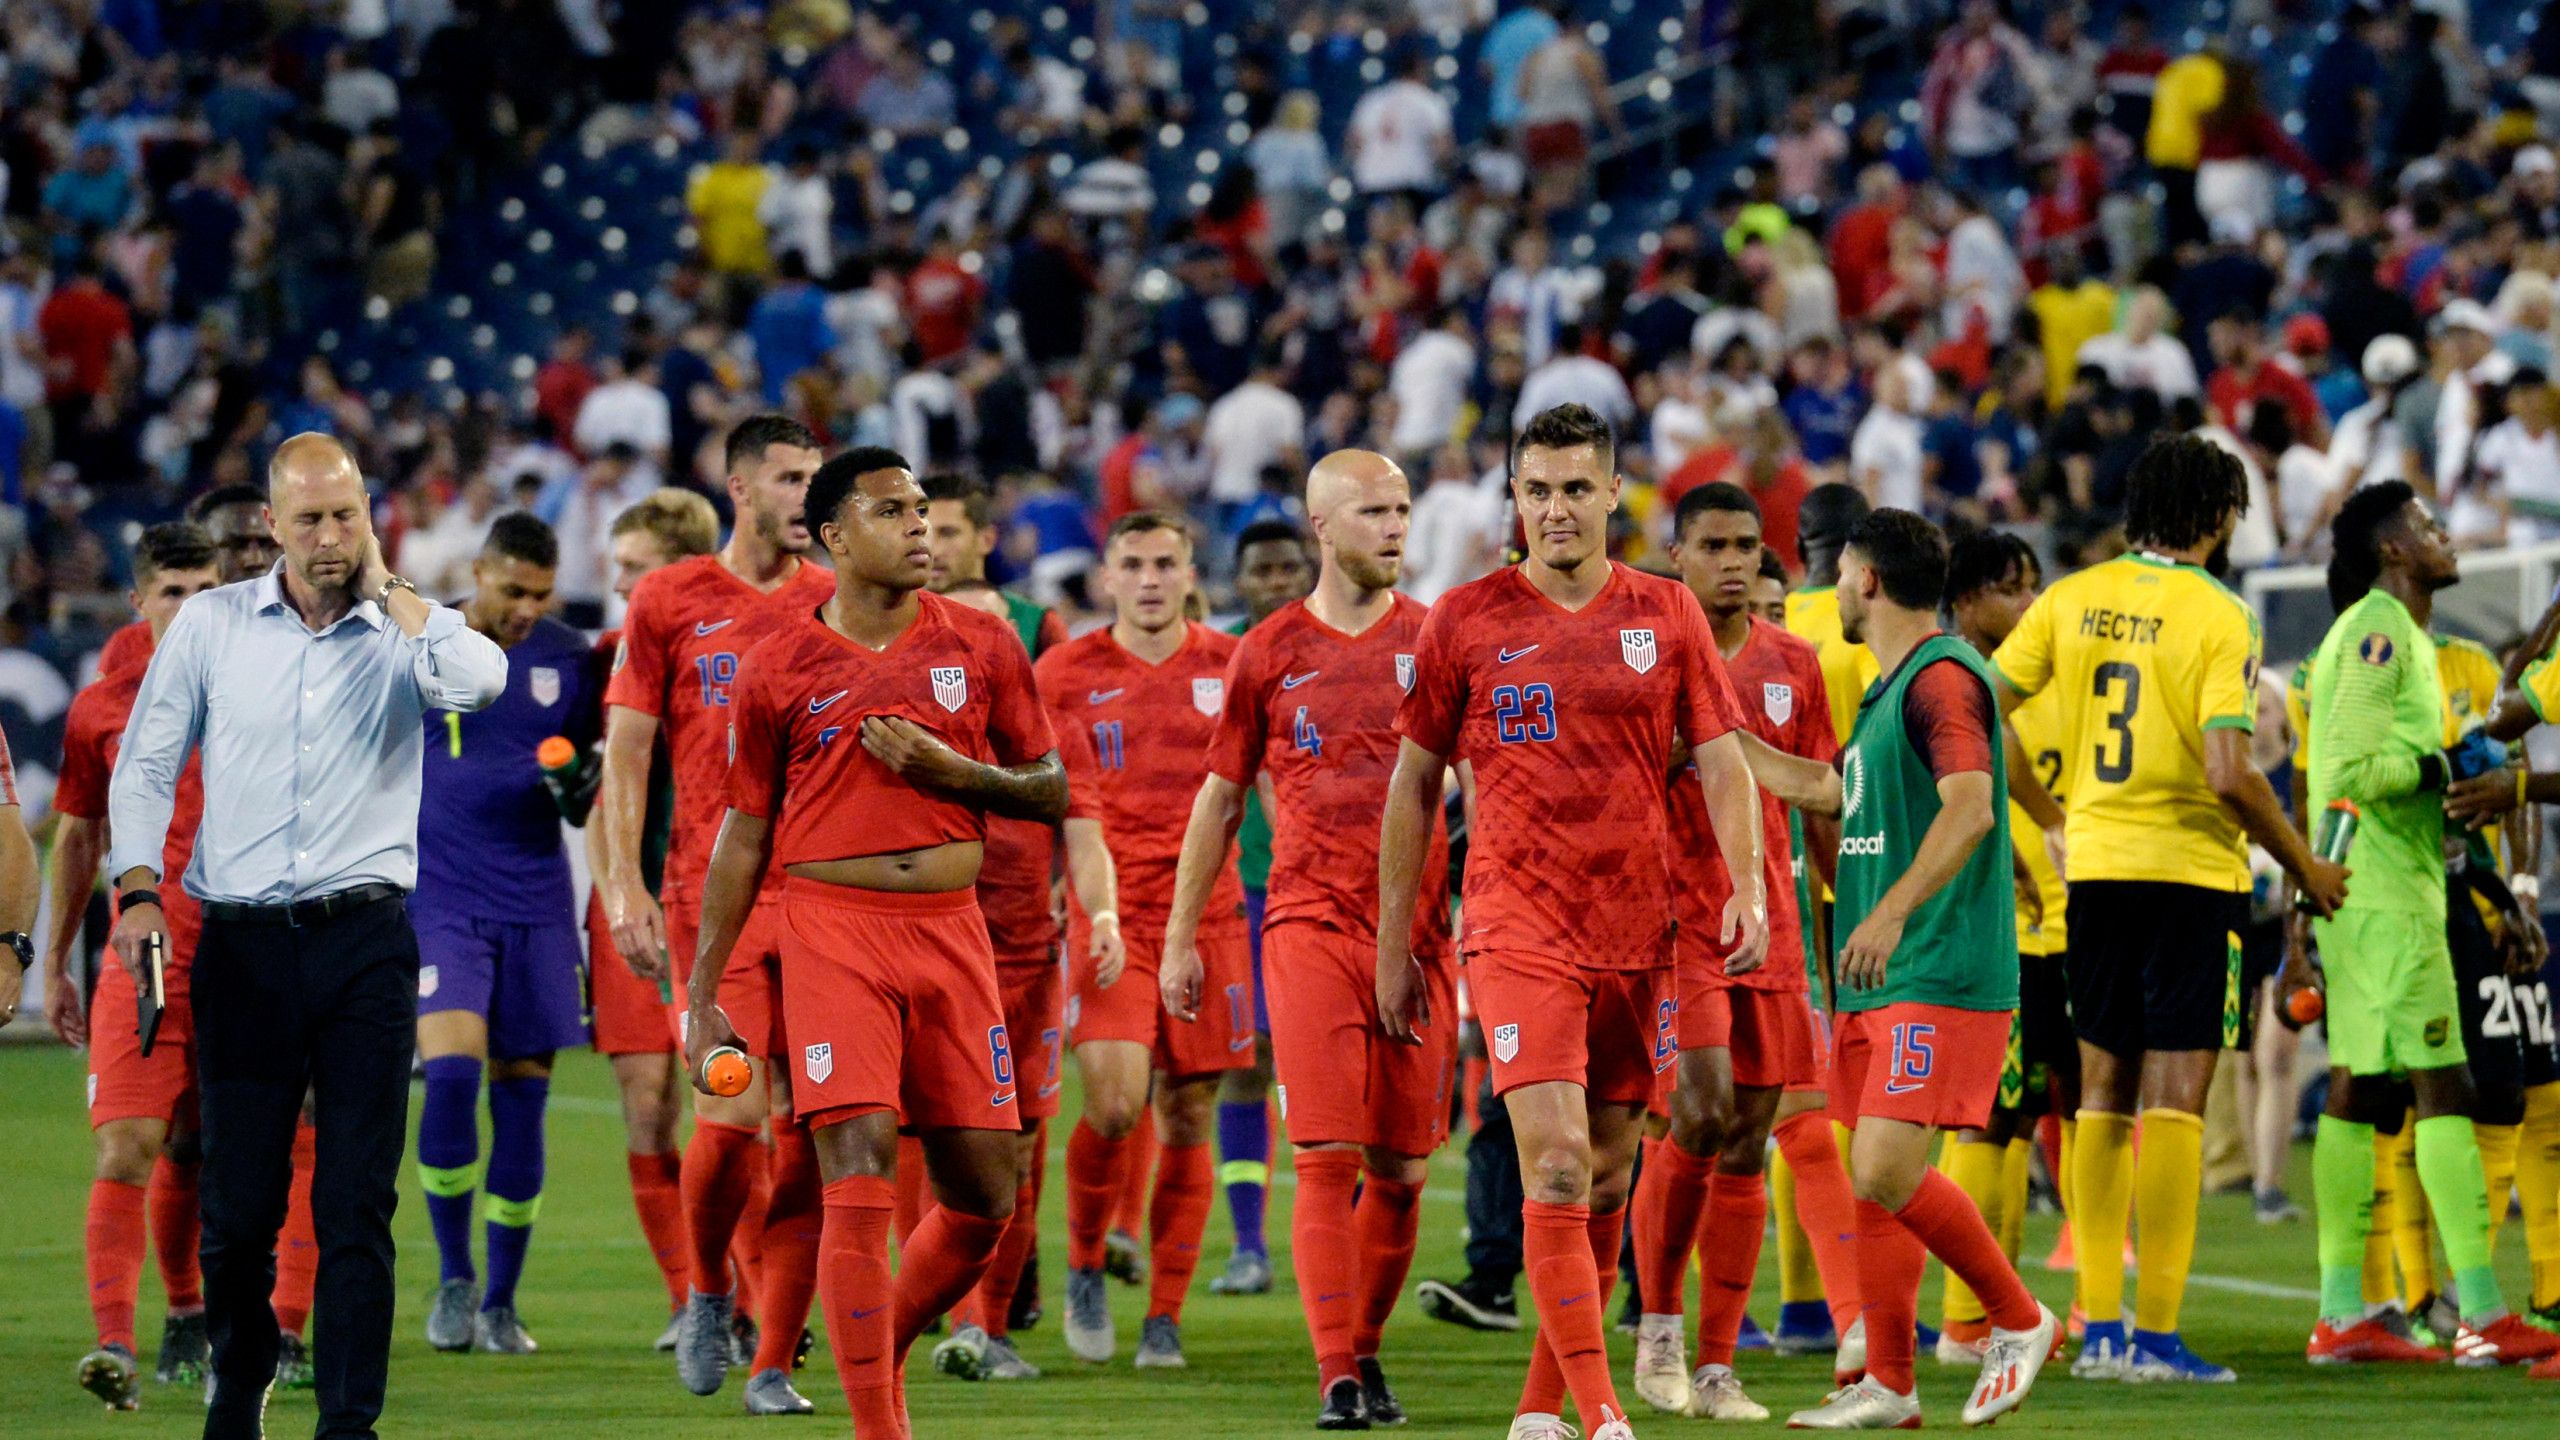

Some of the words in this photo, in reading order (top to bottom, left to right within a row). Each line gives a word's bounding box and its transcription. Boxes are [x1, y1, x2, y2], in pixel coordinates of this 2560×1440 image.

[1623, 631, 1653, 648] USA
[695, 652, 738, 706] 19
[933, 670, 962, 685] USA
[1766, 686, 1789, 701] USA
[444, 711, 461, 758] 1
[1295, 705, 1322, 757] 4
[1493, 682, 1557, 744] 23
[2094, 661, 2140, 783] 3
[1093, 720, 1124, 769] 11
[1839, 830, 1885, 855] acaf
[807, 1045, 829, 1061] USA
[988, 1024, 1013, 1085] 8
[1041, 1028, 1060, 1079] 7
[1495, 1025, 1516, 1041] USA
[1891, 1023, 1936, 1077] 15
